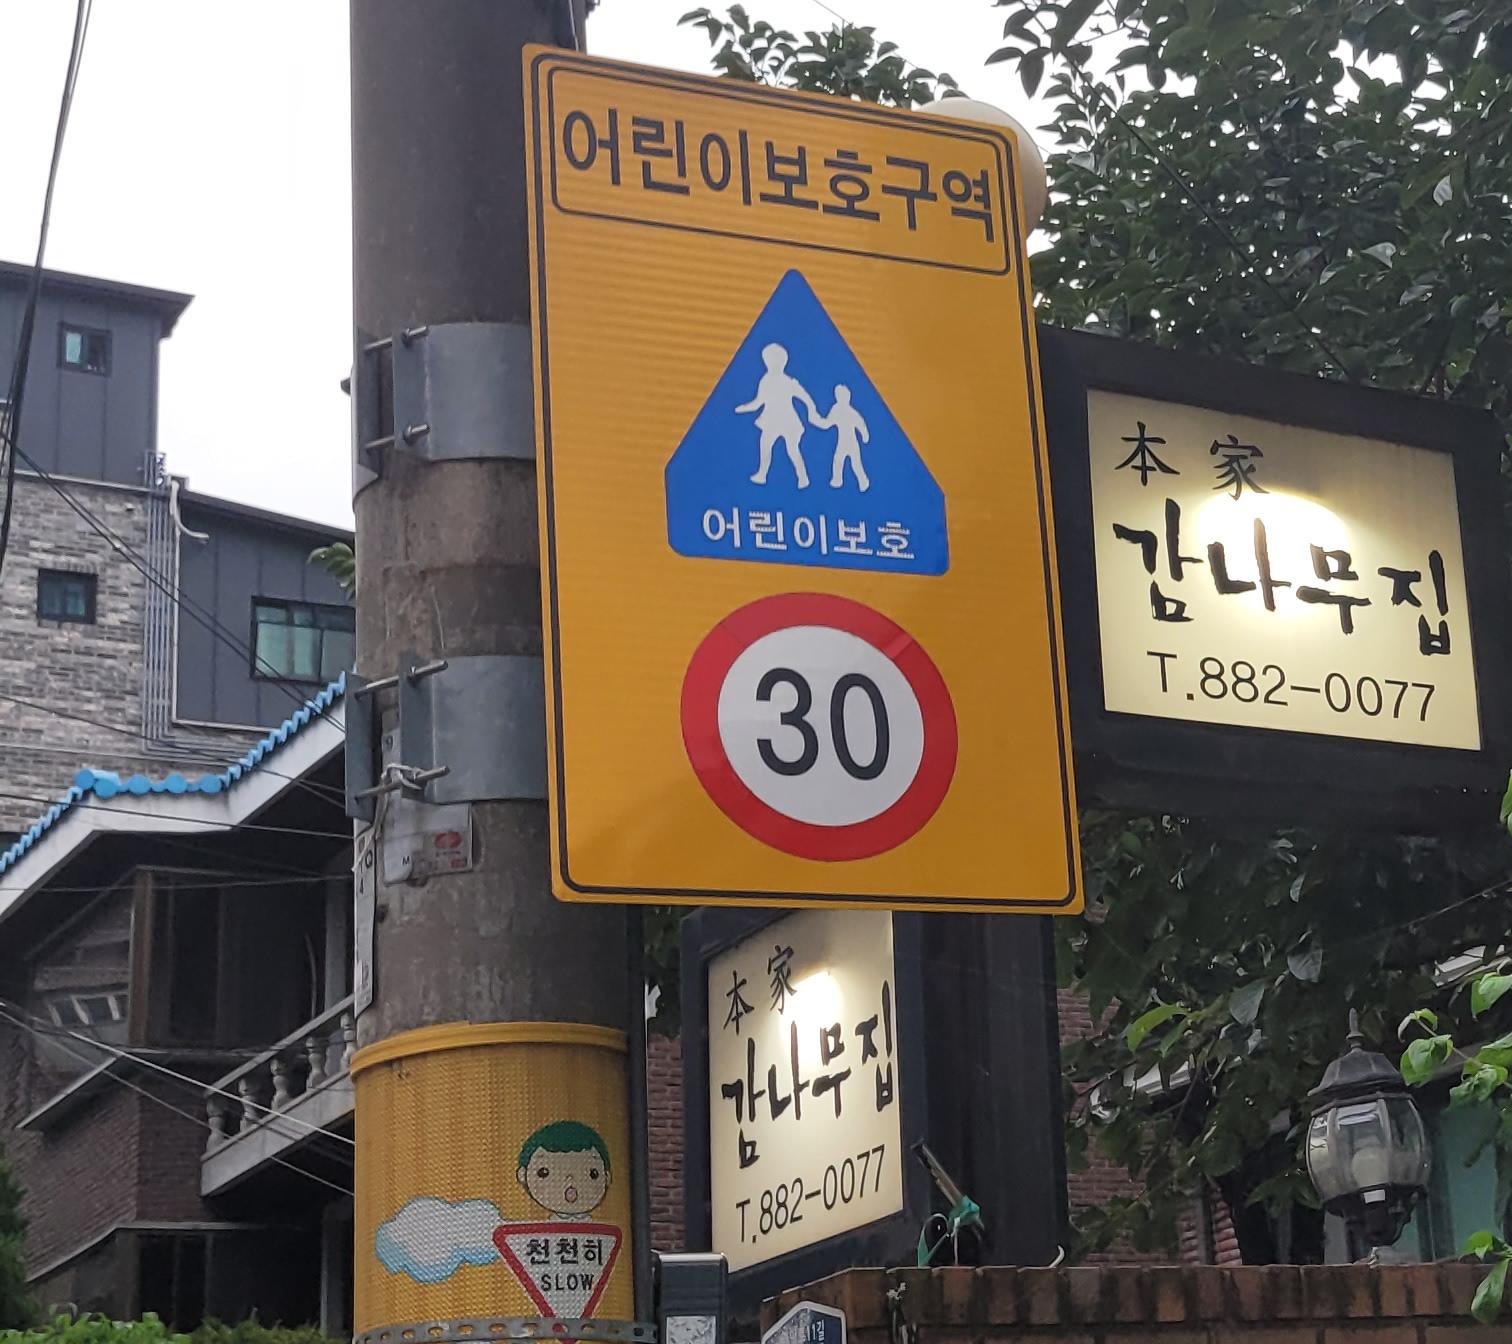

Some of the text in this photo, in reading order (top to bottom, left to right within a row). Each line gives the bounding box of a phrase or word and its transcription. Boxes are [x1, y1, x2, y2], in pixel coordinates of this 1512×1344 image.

[562, 107, 996, 244] 어린이보호구역
[1113, 420, 1270, 501] 本家
[702, 506, 916, 560] 어린이보호
[1112, 497, 1452, 657] 감나무집
[754, 666, 891, 782] 30
[1146, 649, 1436, 722] T.882-0077
[722, 944, 796, 1036] 本家
[721, 979, 897, 1170] 감나무집
[735, 1143, 887, 1246] T.882-0077
[526, 1238, 603, 1266] 천천히
[541, 1273, 595, 1292] SLOW
